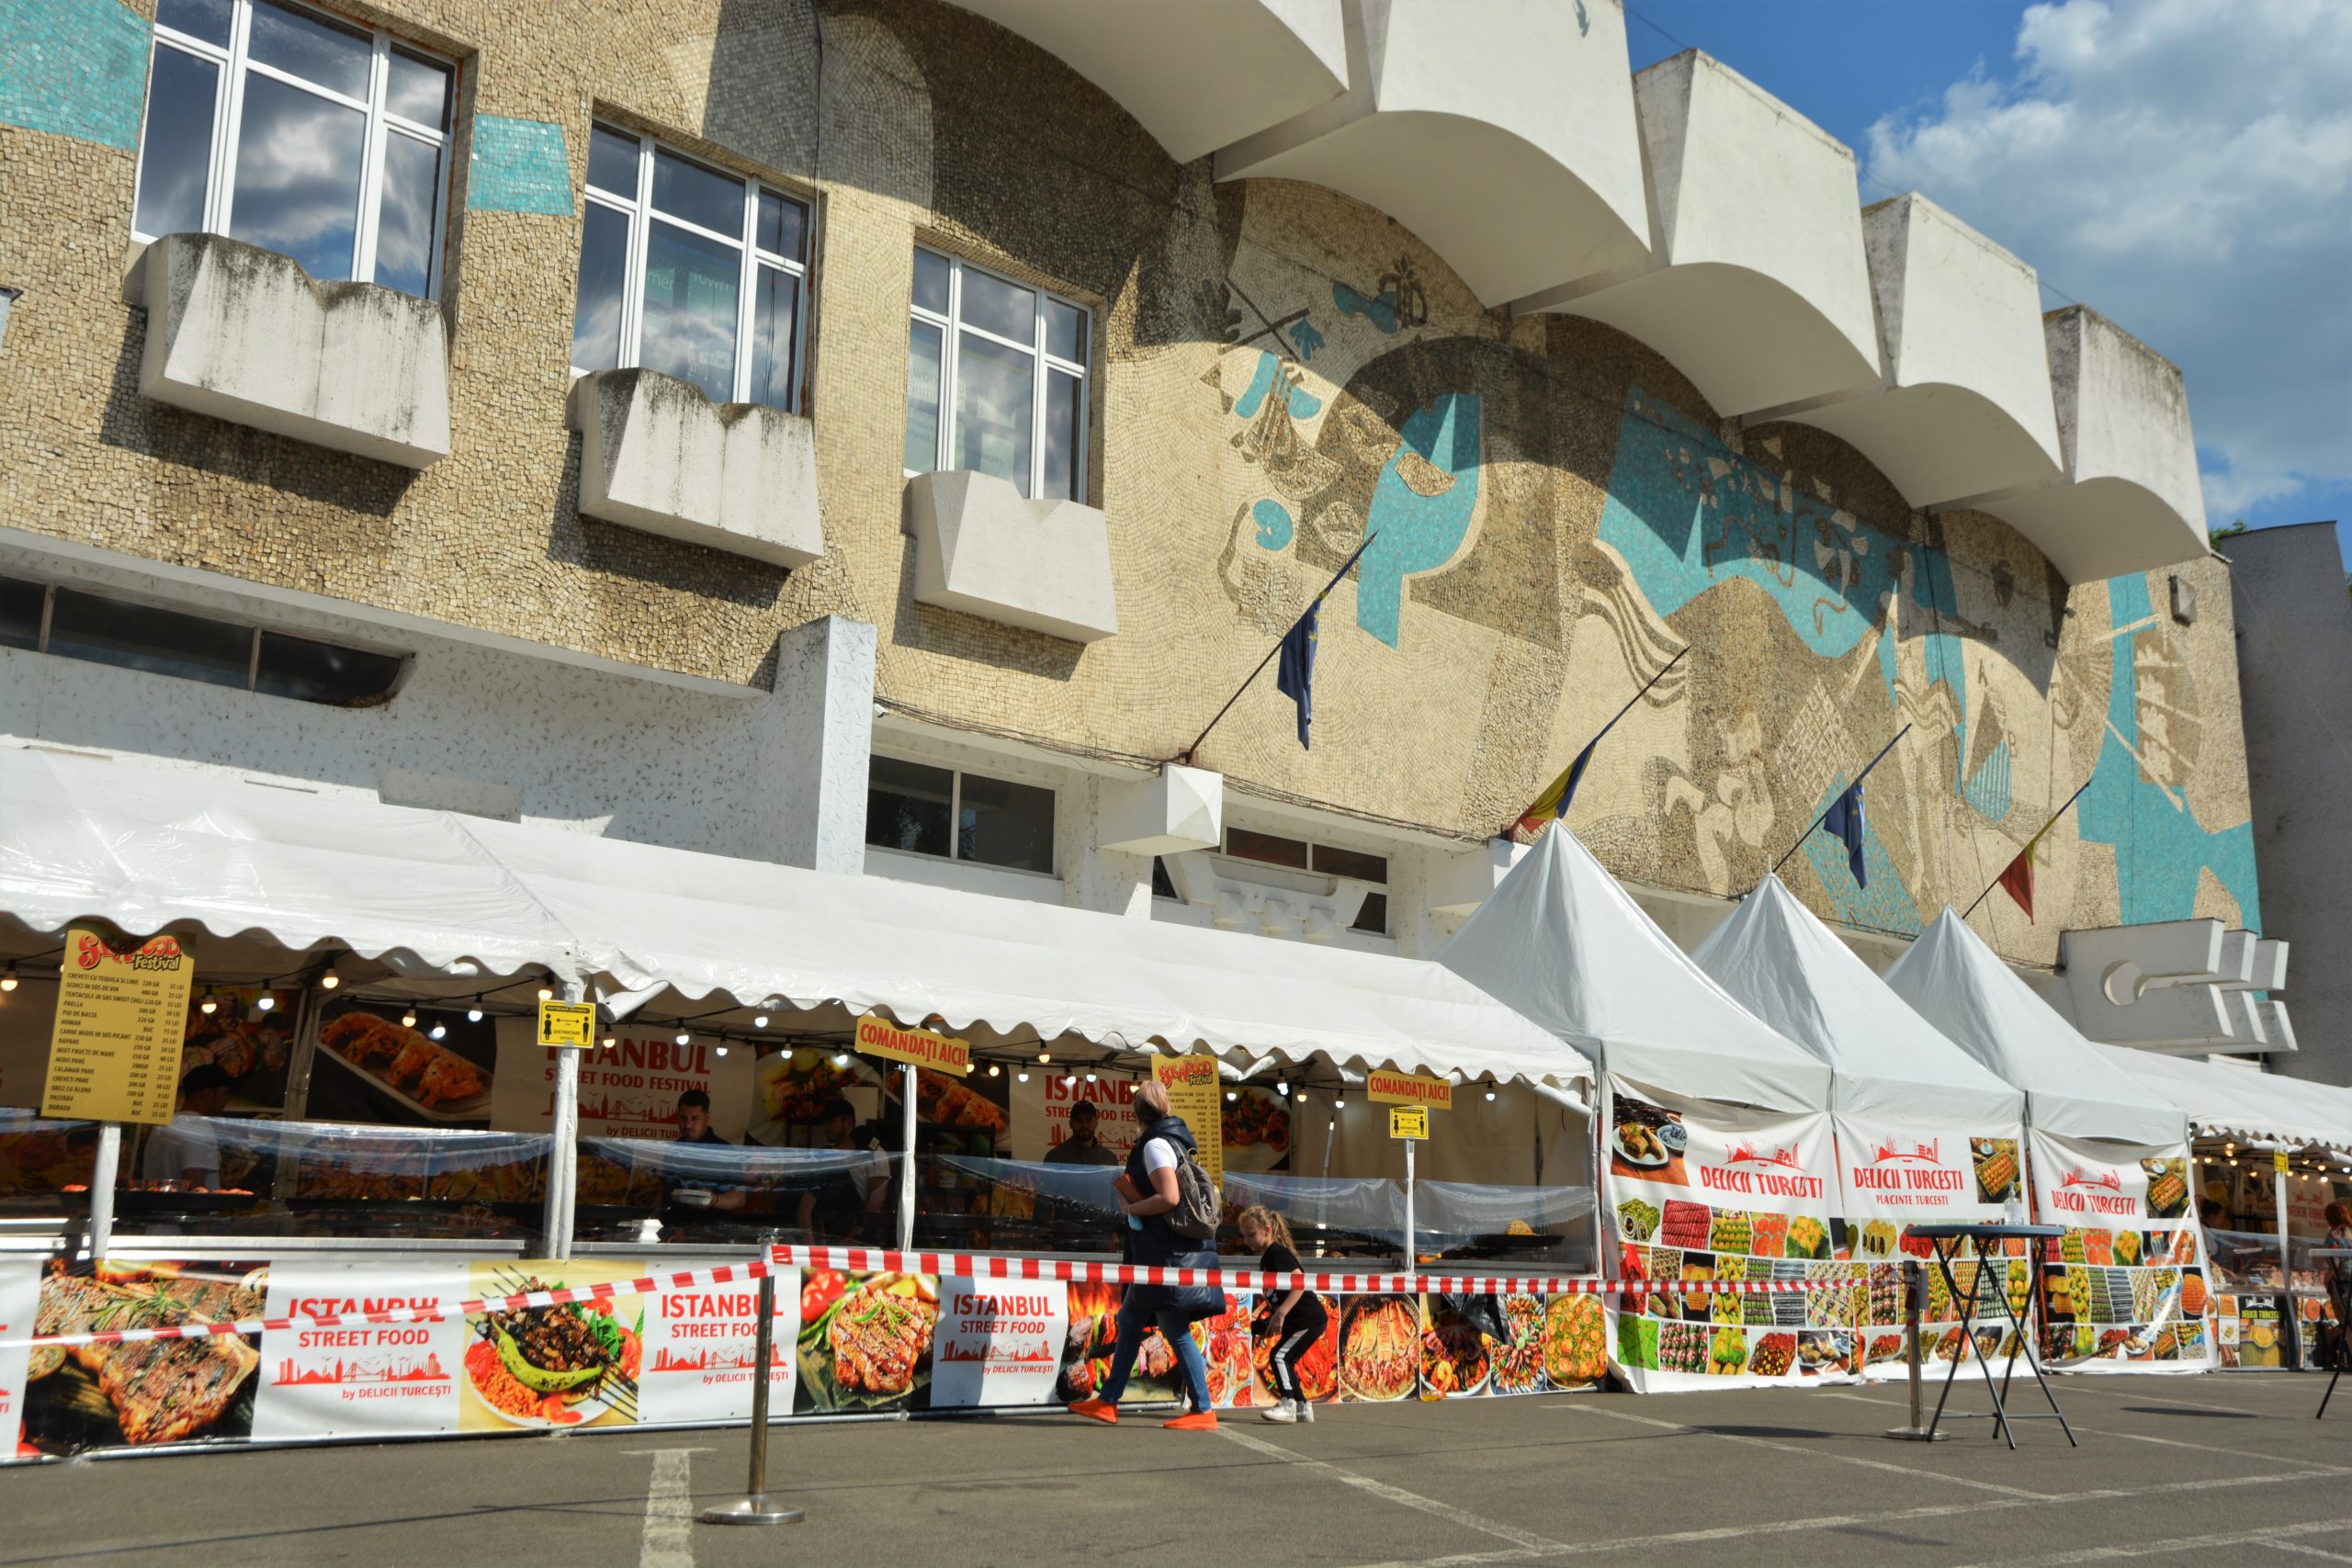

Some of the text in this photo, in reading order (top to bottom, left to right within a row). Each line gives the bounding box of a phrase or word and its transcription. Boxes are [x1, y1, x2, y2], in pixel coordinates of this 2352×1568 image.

[132, 953, 182, 971] Festival
[938, 1043, 967, 1067] AICI!
[602, 1073, 644, 1089] FOOD
[1189, 1071, 1213, 1087] Festival
[1428, 1084, 1449, 1101] AICI!
[606, 1125, 618, 1138] by
[621, 1126, 657, 1138] DELICII
[1700, 1165, 1752, 1194] DELICII
[1853, 1168, 1964, 1190] DELICII TURCESTI
[1875, 1194, 1949, 1205] PLACINTE TURCESTI
[2086, 1194, 2136, 1215] TURCESTI
[662, 1293, 784, 1318] ISTANBL
[953, 1293, 1055, 1317] ISTANBUL
[671, 1323, 728, 1338] STREET
[960, 1320, 1046, 1334] STREET FOOD
[299, 1329, 430, 1348] STREET FOOD
[981, 1366, 991, 1375] by
[992, 1365, 1019, 1373] DELICII
[702, 1374, 713, 1385] by
[716, 1372, 746, 1382] DELICII
[342, 1388, 356, 1401] by
[358, 1387, 398, 1398] DELICII
